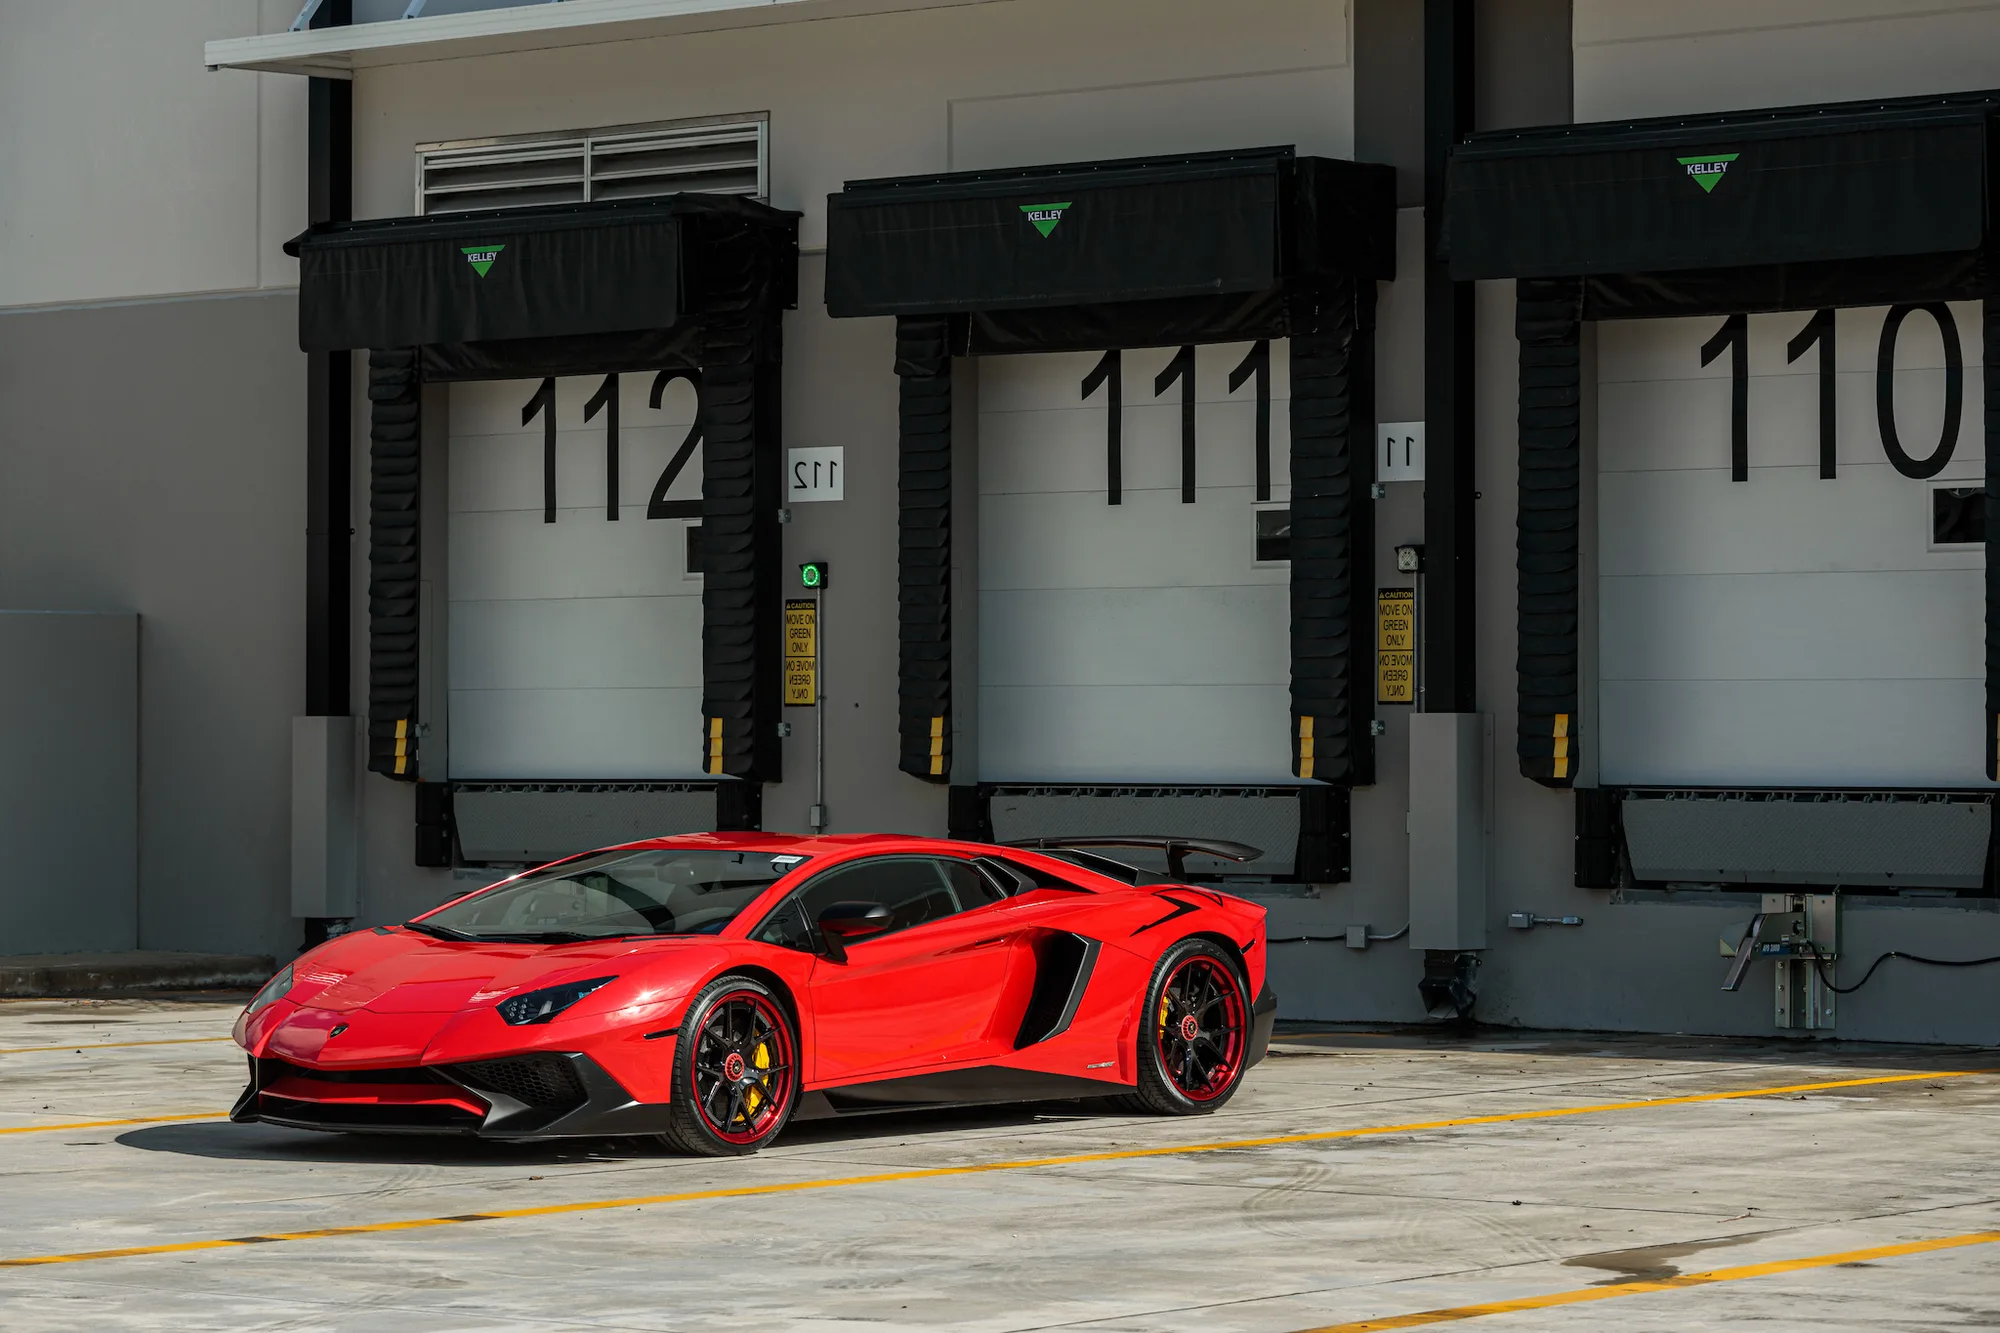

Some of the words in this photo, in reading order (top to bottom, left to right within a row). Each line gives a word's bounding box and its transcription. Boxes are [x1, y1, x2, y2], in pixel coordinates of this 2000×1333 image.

[1687, 162, 1728, 175] KELLEY
[1028, 210, 1062, 221] KELLEY
[467, 252, 497, 262] KELLEY
[1701, 302, 1963, 482] 110
[1082, 339, 1270, 505] 111
[522, 369, 703, 523] 112
[1380, 604, 1400, 615] MOVE
[1402, 604, 1412, 615] ON
[786, 614, 804, 624] MOVE
[805, 614, 815, 624] ON
[1383, 619, 1408, 630] GREEN
[790, 628, 811, 638] GREEN
[1386, 634, 1405, 646] ONLY
[792, 642, 808, 653] ONLY
